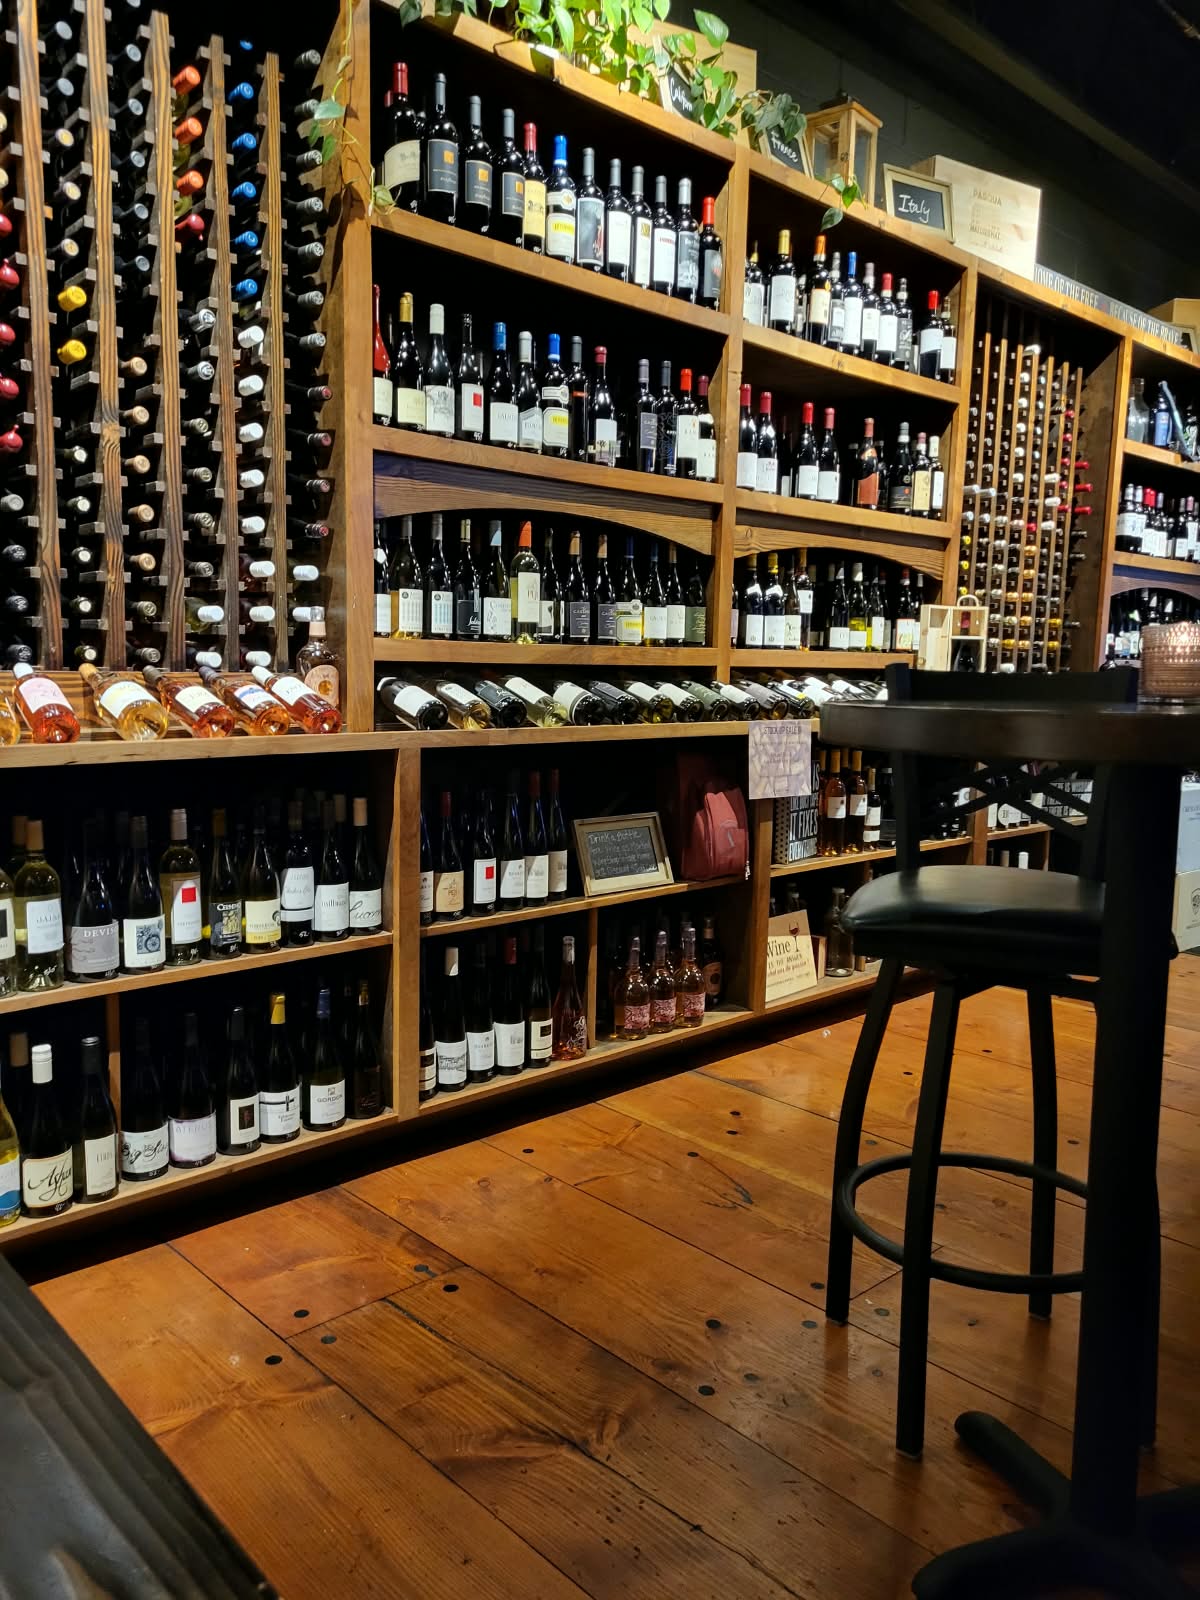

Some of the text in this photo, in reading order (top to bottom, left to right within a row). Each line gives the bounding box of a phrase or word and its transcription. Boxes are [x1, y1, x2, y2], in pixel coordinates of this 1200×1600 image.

[898, 194, 931, 224] Italy
[1066, 282, 1080, 302] THE
[1081, 289, 1099, 309] FREE
[1109, 302, 1138, 326] BECAUSE
[1160, 326, 1180, 344] BRAVE
[812, 761, 820, 791] IS
[790, 808, 819, 841] IT FIXES
